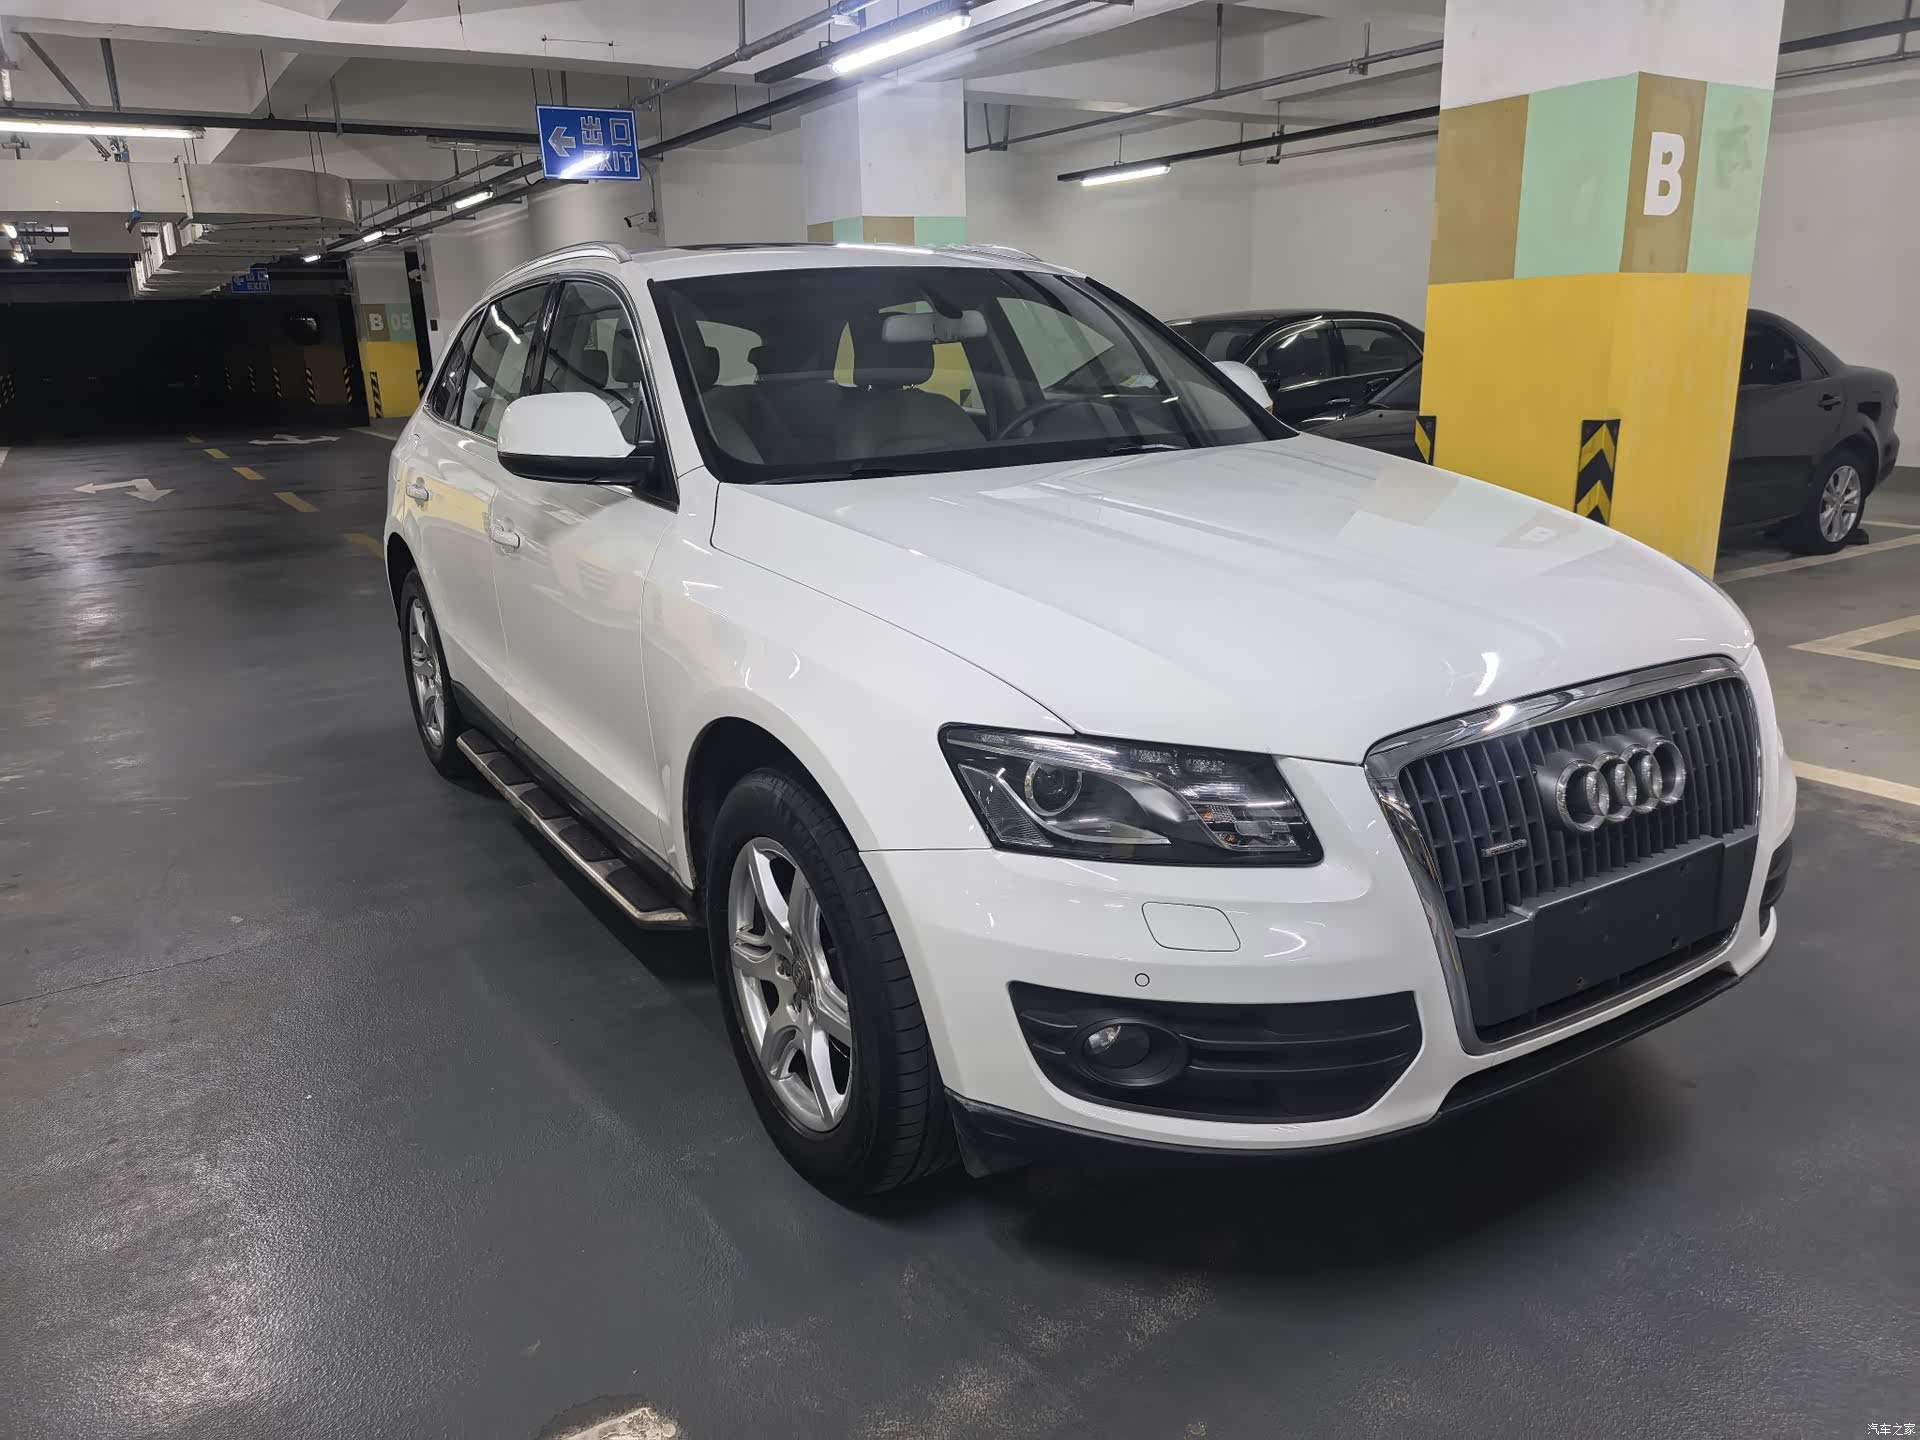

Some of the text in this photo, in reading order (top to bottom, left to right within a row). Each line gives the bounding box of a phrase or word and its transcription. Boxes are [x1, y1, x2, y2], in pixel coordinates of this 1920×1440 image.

[580, 115, 632, 146] 出口
[583, 150, 633, 172] EXIT
[1643, 131, 1686, 217] B
[247, 282, 268, 291] EXIT
[368, 313, 385, 331] B
